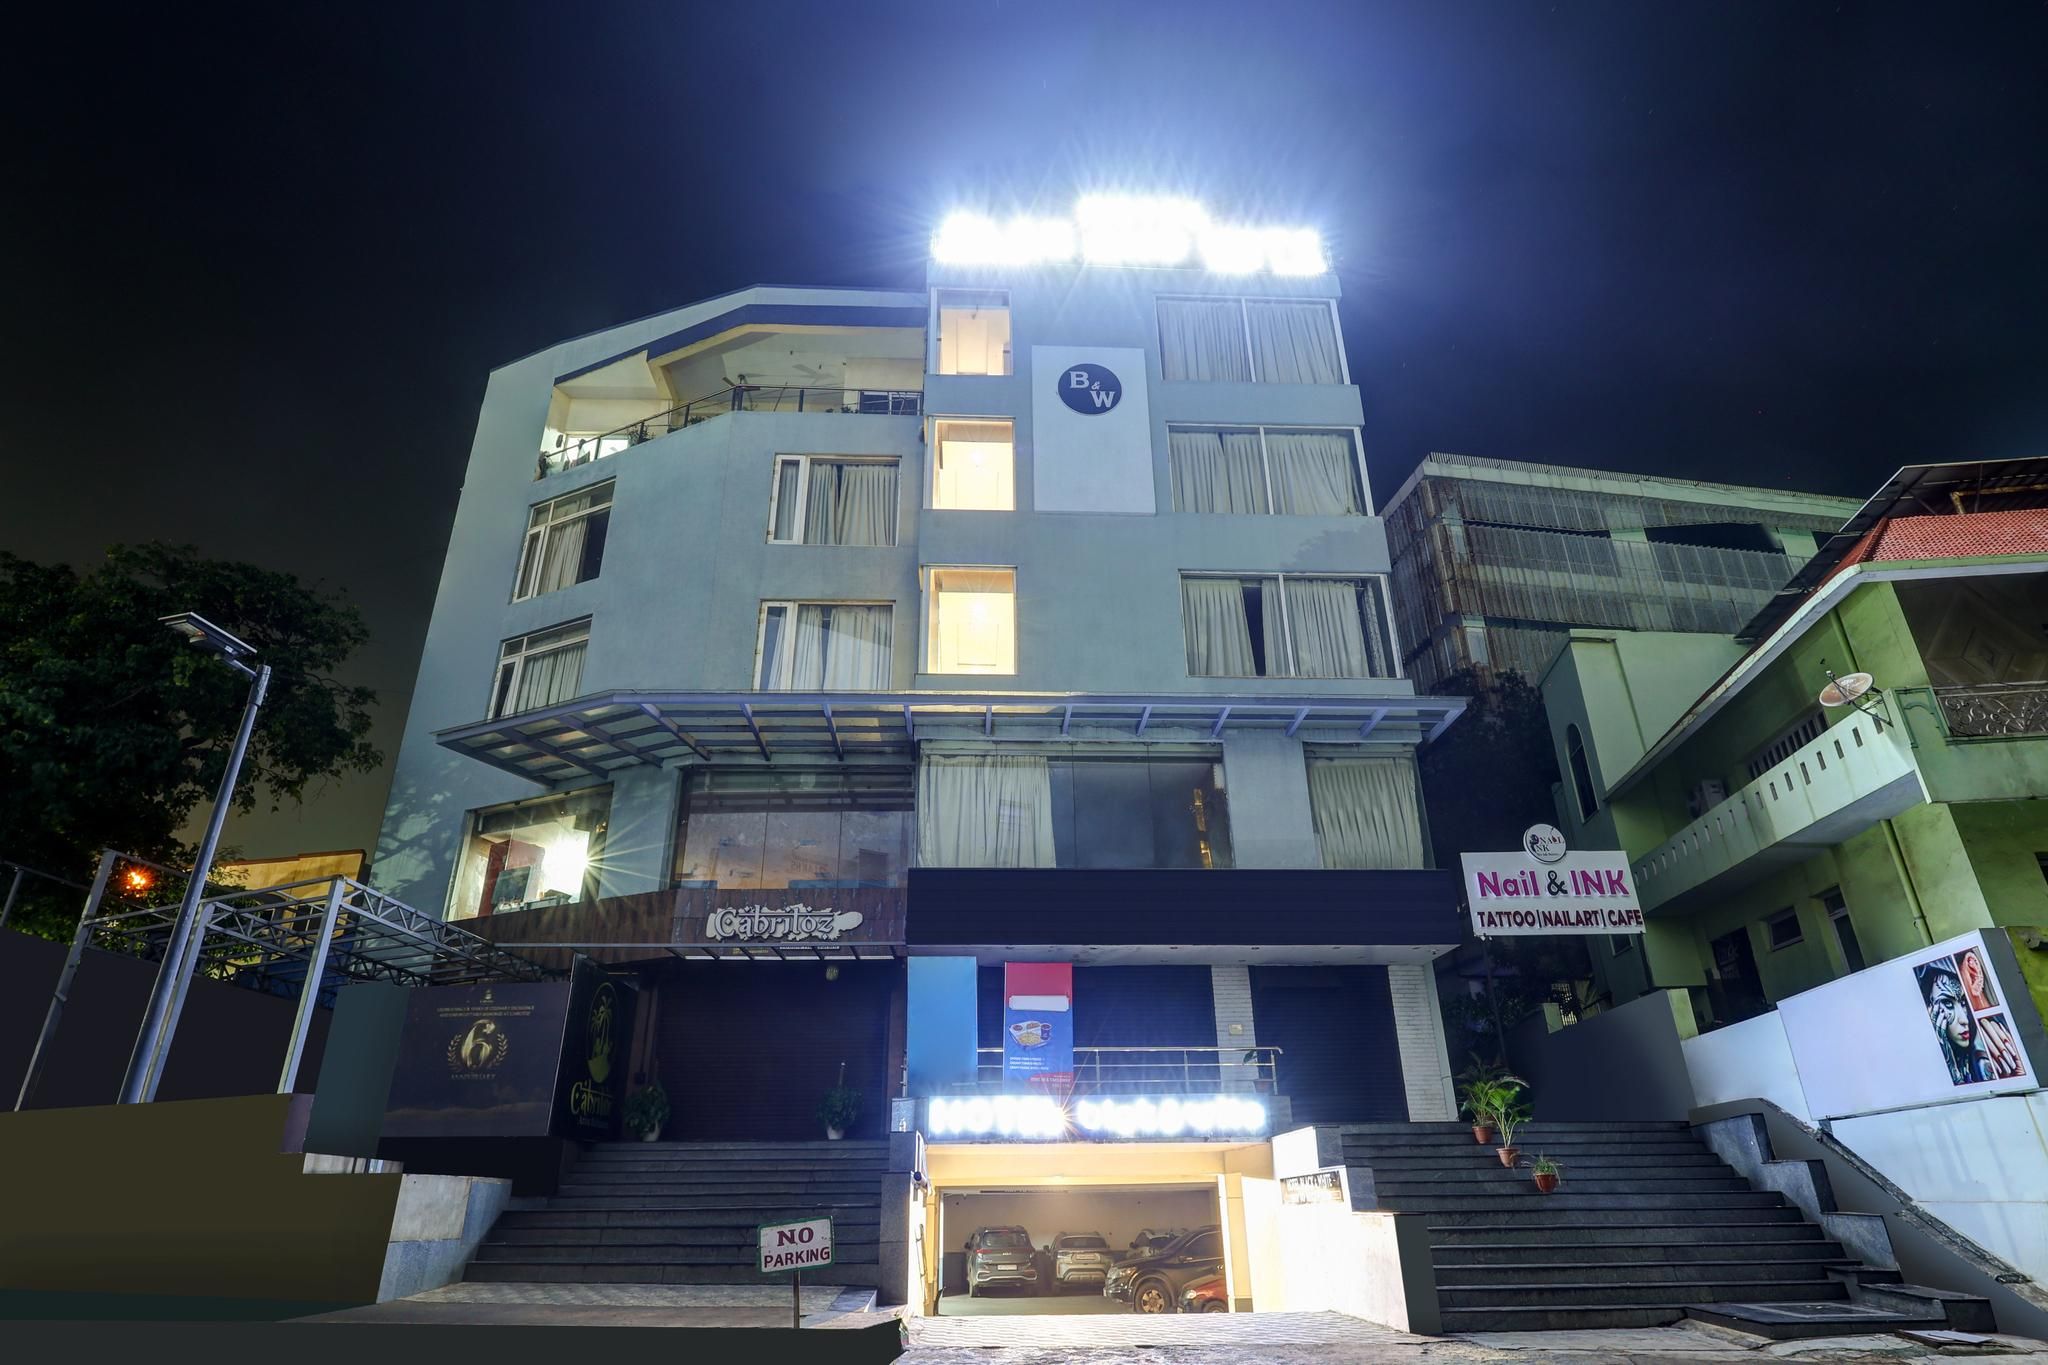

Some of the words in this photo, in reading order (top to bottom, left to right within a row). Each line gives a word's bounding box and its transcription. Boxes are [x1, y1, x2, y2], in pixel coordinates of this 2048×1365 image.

[1069, 371, 1090, 389] B
[1089, 390, 1116, 408] W
[1476, 870, 1540, 897] Nail
[1547, 870, 1568, 896] &
[1569, 869, 1630, 896] INK
[1608, 908, 1643, 926] CAFE
[776, 1227, 814, 1247] NO
[763, 1246, 831, 1269] PARKING
